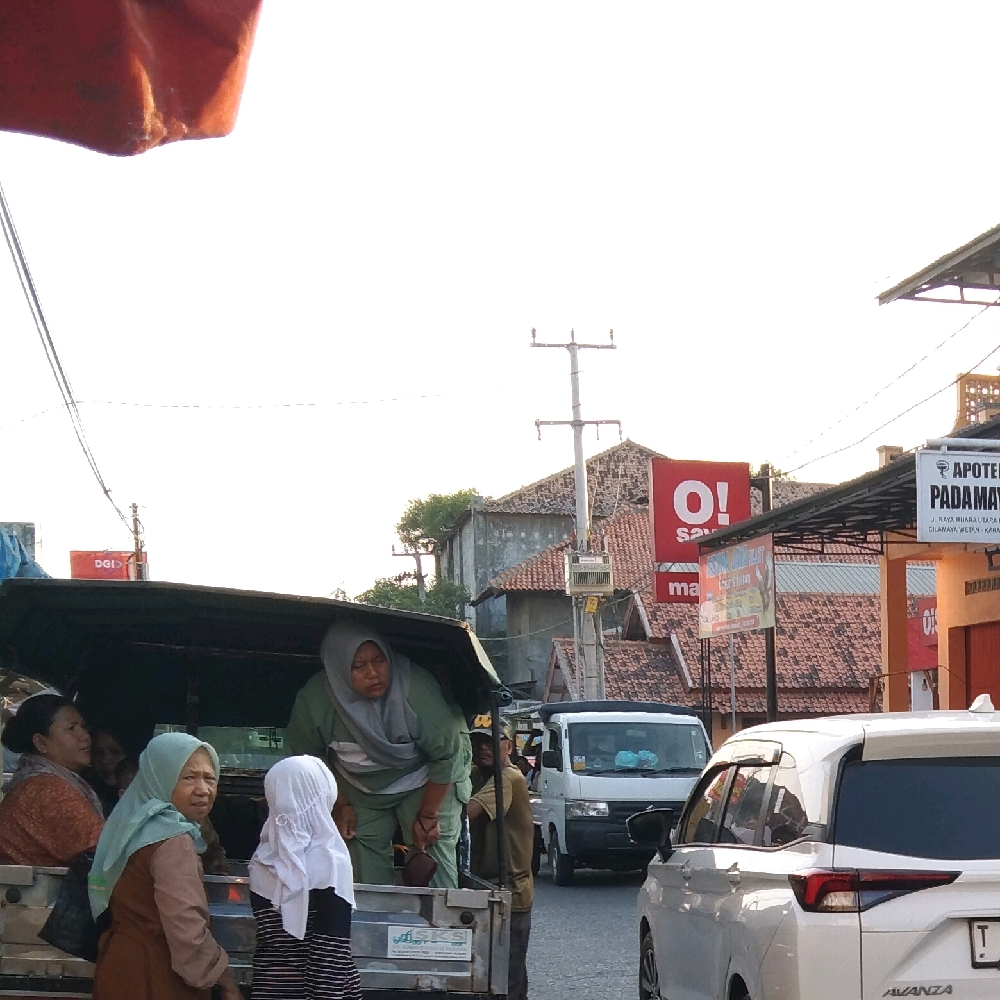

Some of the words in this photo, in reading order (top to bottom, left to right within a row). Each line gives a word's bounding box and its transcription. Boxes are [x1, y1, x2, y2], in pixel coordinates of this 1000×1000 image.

[673, 479, 729, 525] O!
[977, 924, 989, 947] T
[881, 984, 953, 997] AVANZA
